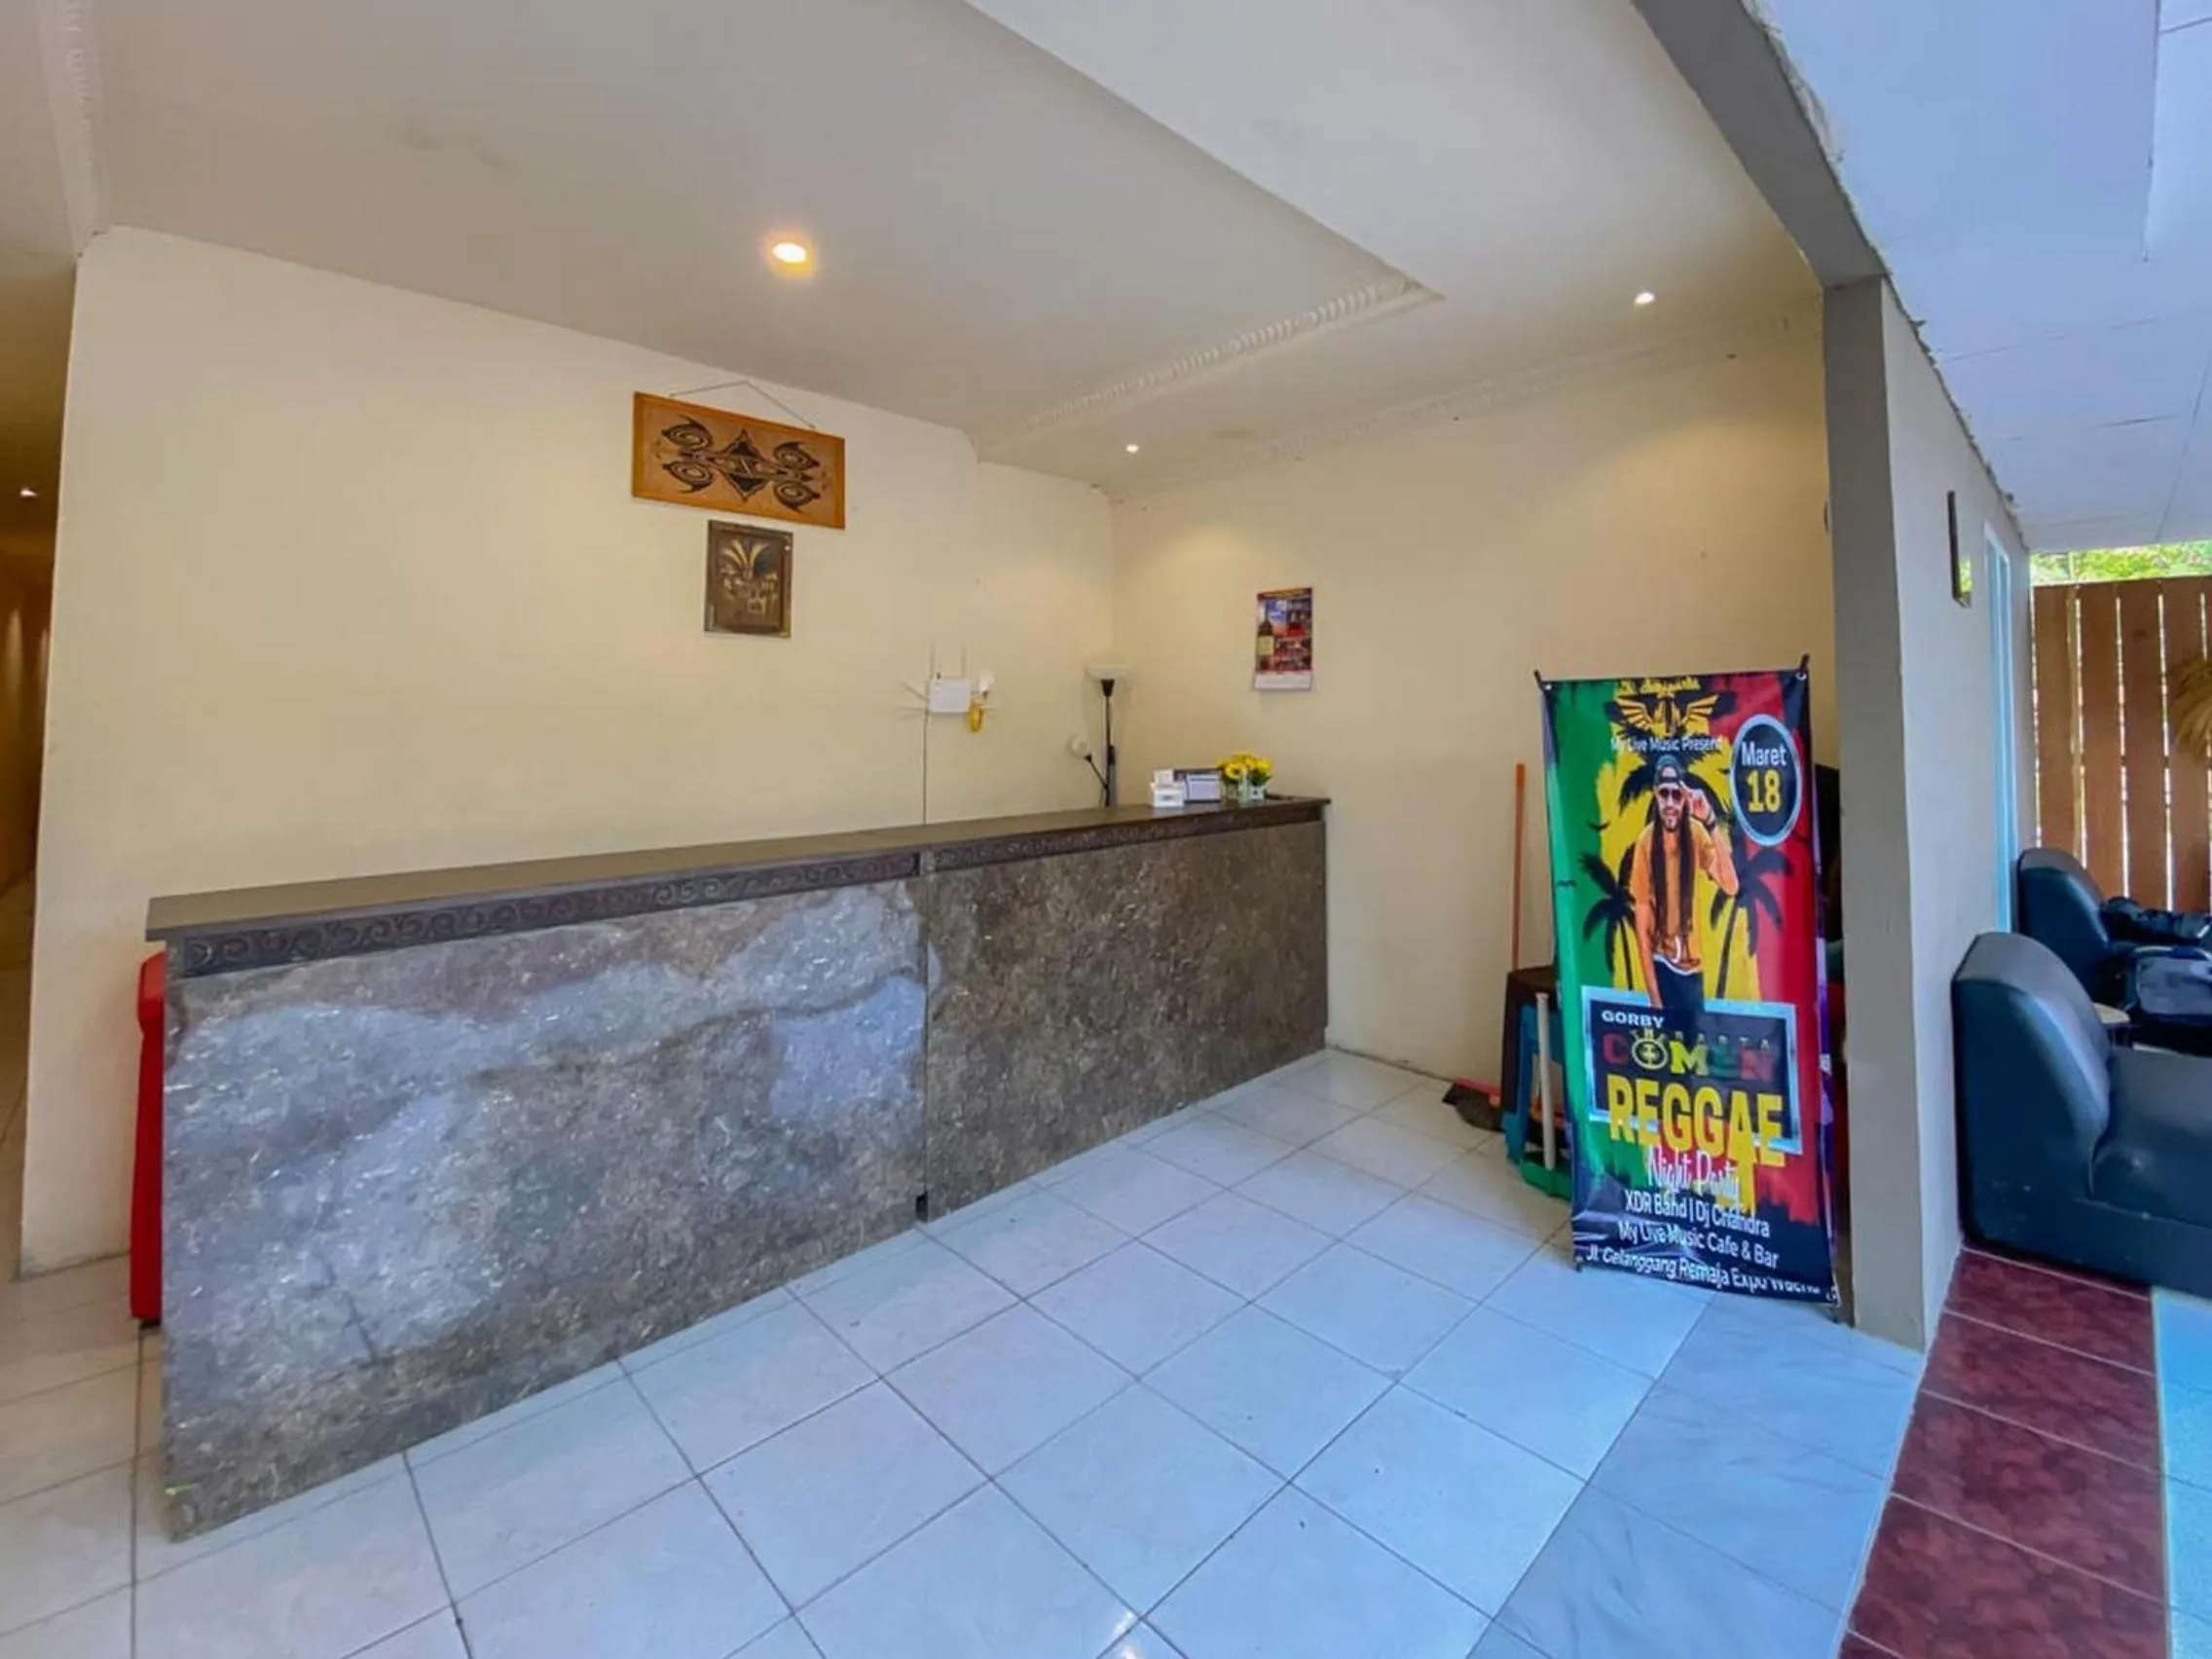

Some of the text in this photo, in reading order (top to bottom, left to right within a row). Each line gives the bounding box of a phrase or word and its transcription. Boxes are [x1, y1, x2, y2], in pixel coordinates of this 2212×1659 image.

[1649, 735, 1680, 753] Music
[1741, 741, 1788, 767] Maret
[1747, 768, 1782, 813] 18
[1601, 1010, 1666, 1029] GORBY
[1607, 1074, 1787, 1167] REGGAE
[1625, 1189, 1652, 1214] XDR
[1654, 1192, 1687, 1219] Band
[1696, 1199, 1711, 1229] Dj
[1617, 1219, 1781, 1270] My Live Music Cafe & Bar
[1678, 1257, 1730, 1289] Remaja
